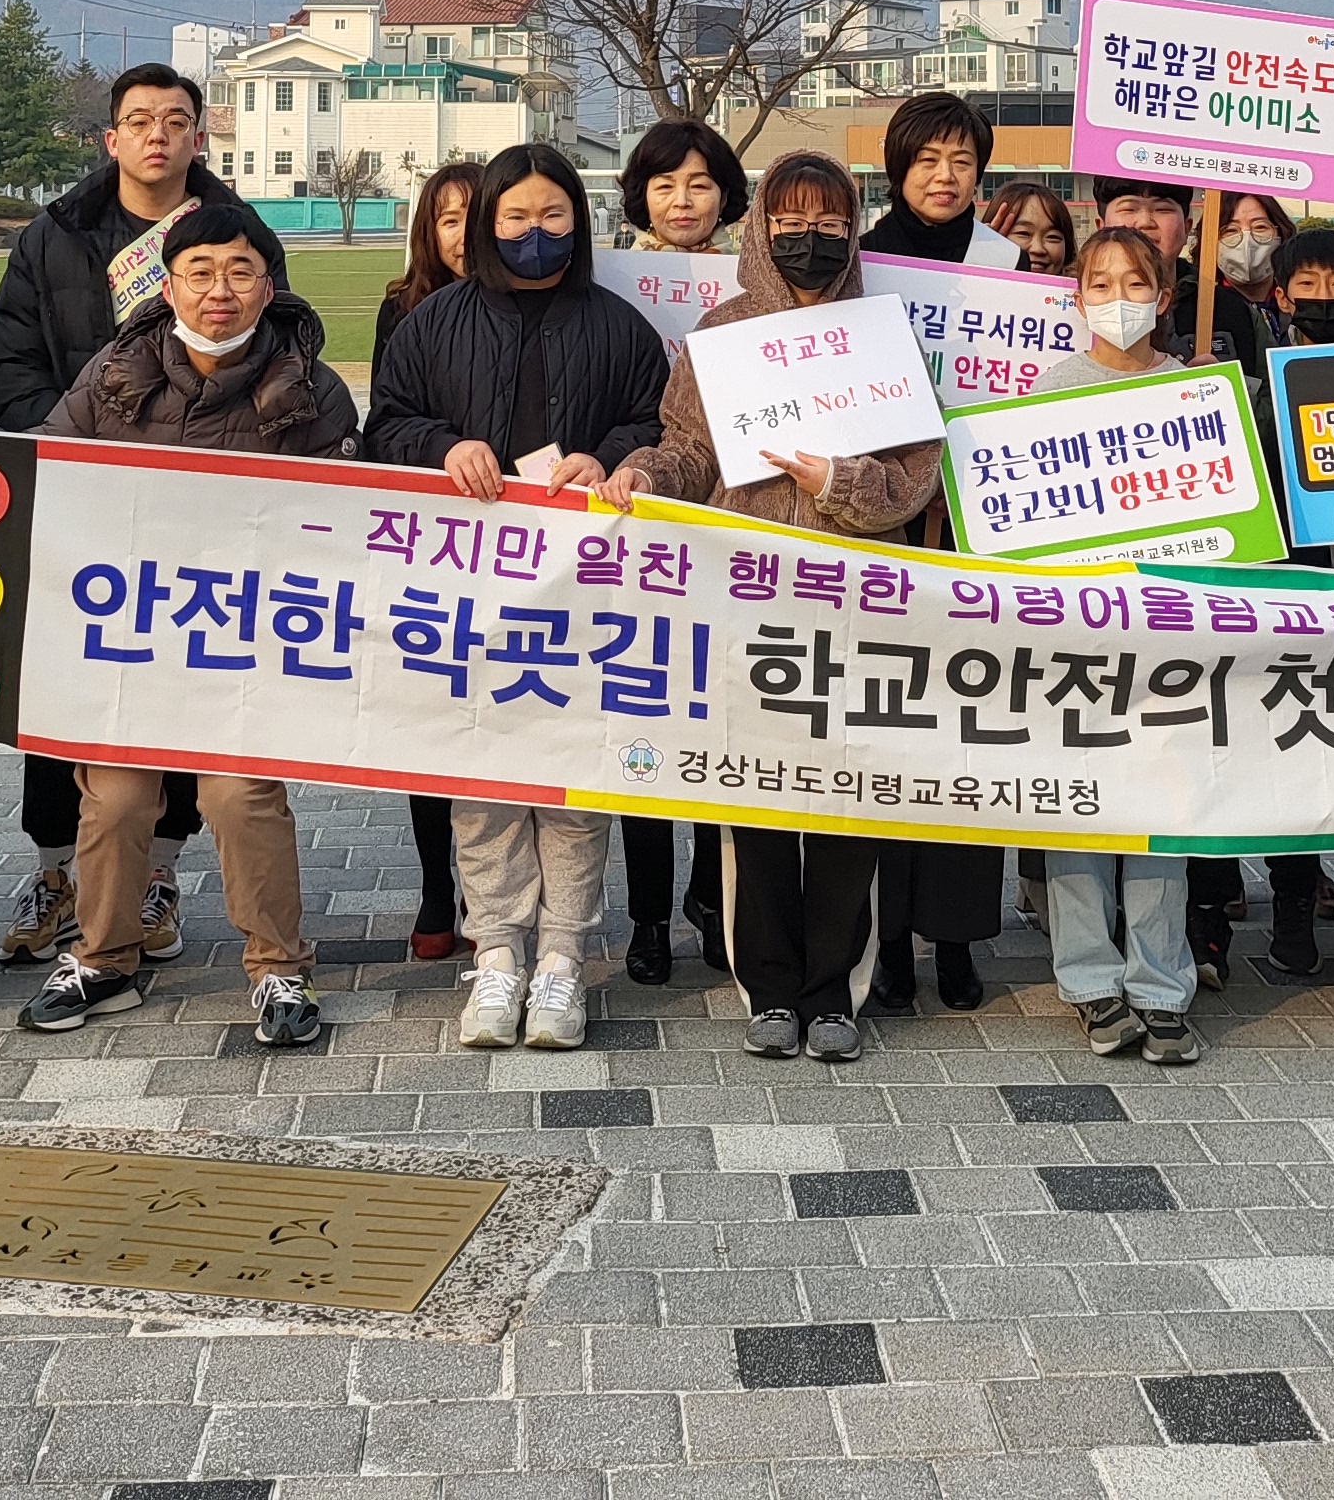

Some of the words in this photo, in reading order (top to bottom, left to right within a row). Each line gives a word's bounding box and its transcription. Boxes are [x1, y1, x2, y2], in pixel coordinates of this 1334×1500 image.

[1104, 33, 1217, 81] 학교앞길
[1114, 78, 1200, 121] 해맑은
[1208, 91, 1321, 134] 아이미소
[1153, 151, 1299, 182] 경상남도의령교육지원청
[637, 276, 723, 308] 학교앞
[759, 327, 852, 367] 학교앞
[958, 310, 1076, 352] 무서워요
[812, 387, 858, 414] No!
[867, 376, 912, 403] No!
[954, 355, 1045, 396] 안전운
[970, 431, 1092, 488] 웃는엄마
[1096, 408, 1227, 466] 밝은아빠
[981, 477, 1105, 533] 알고보니
[1110, 455, 1237, 511] 양보운전
[366, 509, 548, 581] 작지만
[576, 534, 693, 597] 알찬
[728, 550, 915, 616] 행복한
[70, 559, 365, 681] 안전한
[388, 585, 711, 720] 학굣길!
[745, 623, 1236, 748] 학교안전의
[676, 748, 1101, 817] 경상남도의령교육지원청
